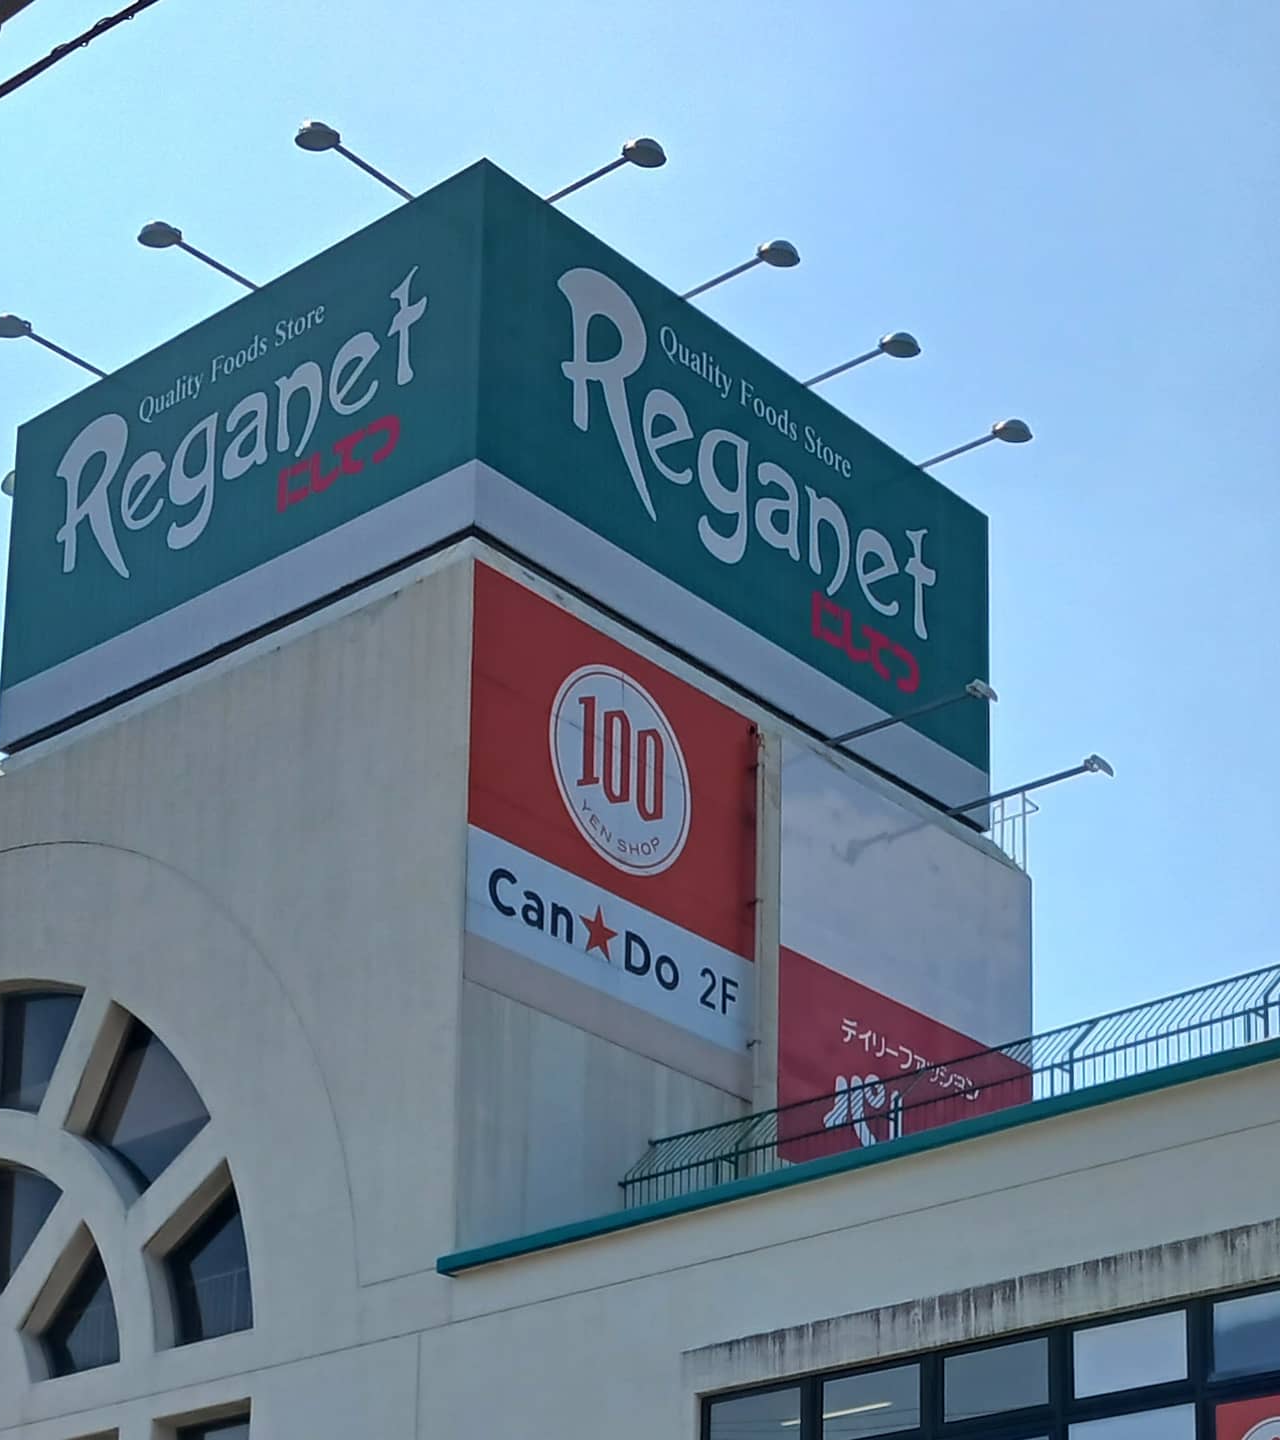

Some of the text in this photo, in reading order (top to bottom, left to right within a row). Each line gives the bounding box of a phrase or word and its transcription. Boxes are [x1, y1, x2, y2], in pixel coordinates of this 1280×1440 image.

[55, 265, 428, 579] Reganet
[138, 303, 326, 423] Quality Foods Store
[659, 325, 853, 479] Quality Foods Store
[556, 267, 937, 640] Reganet
[576, 695, 665, 823] 100
[581, 799, 661, 857] YEN SHOP
[699, 967, 739, 1016] 2F
